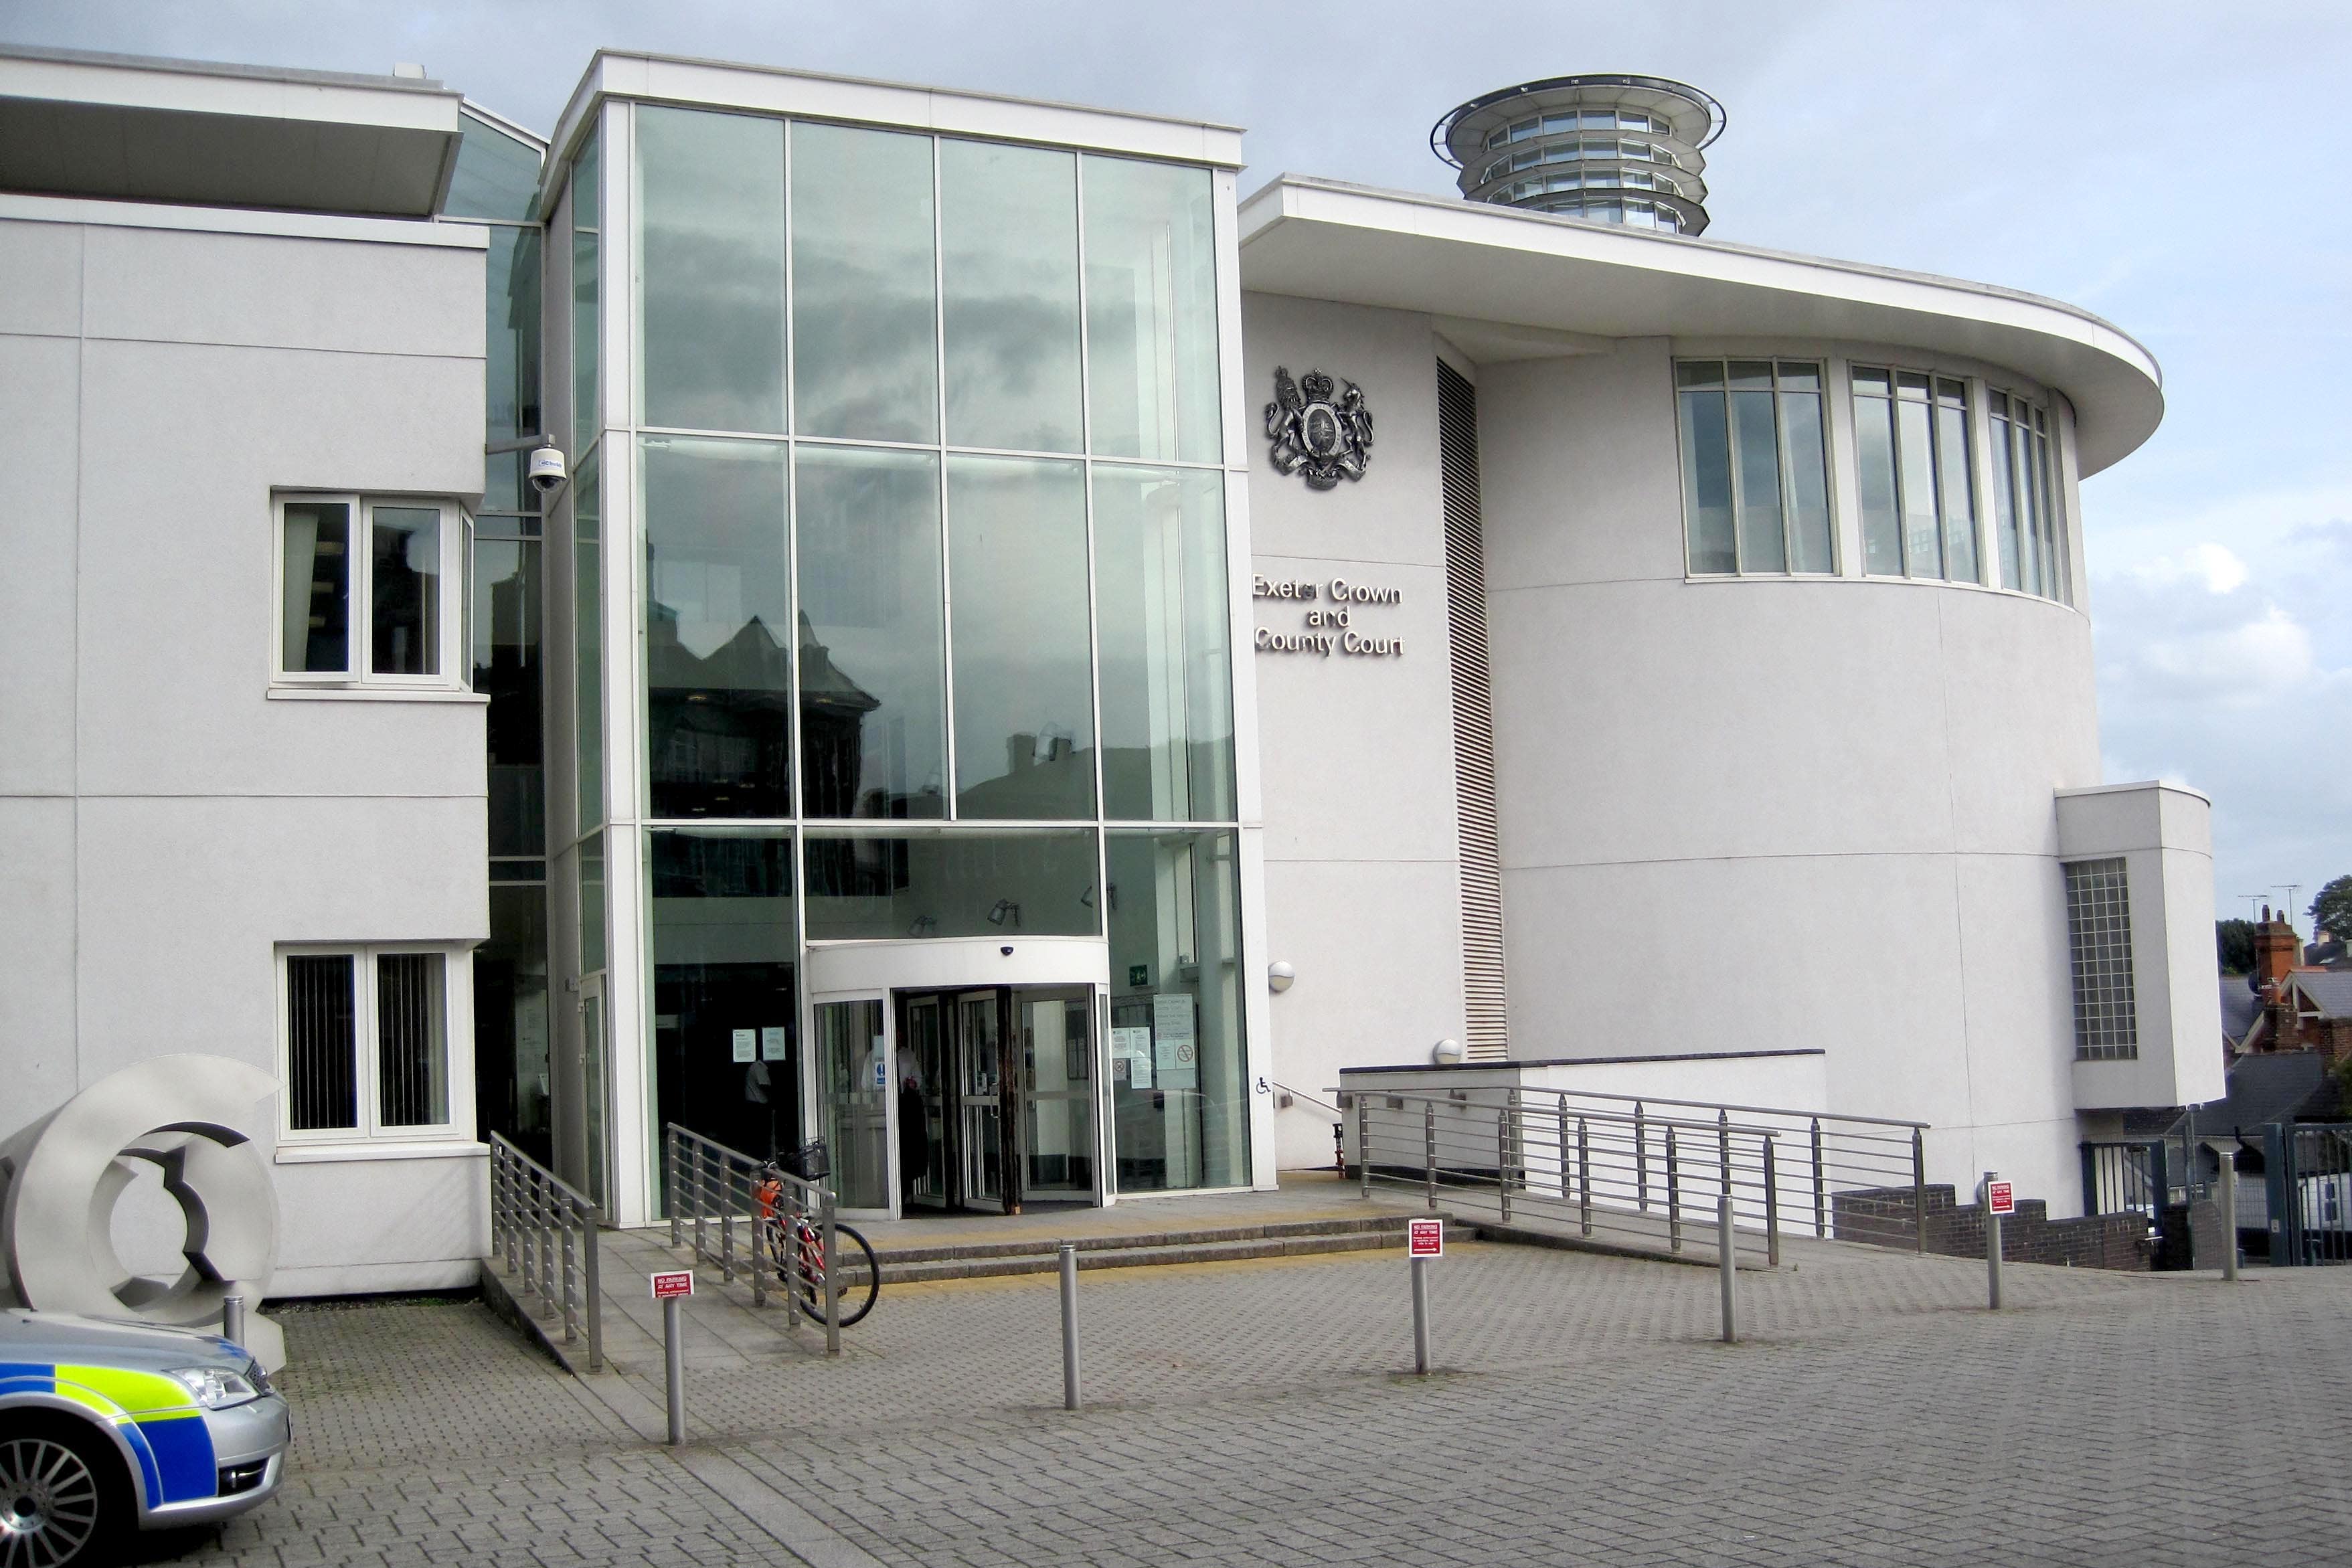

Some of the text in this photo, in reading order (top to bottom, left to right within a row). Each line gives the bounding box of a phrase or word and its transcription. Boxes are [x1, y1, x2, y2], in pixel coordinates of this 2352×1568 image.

[1252, 574, 1404, 604] Exeter Crown
[1309, 606, 1351, 627] and
[1255, 626, 1406, 657] County Court
